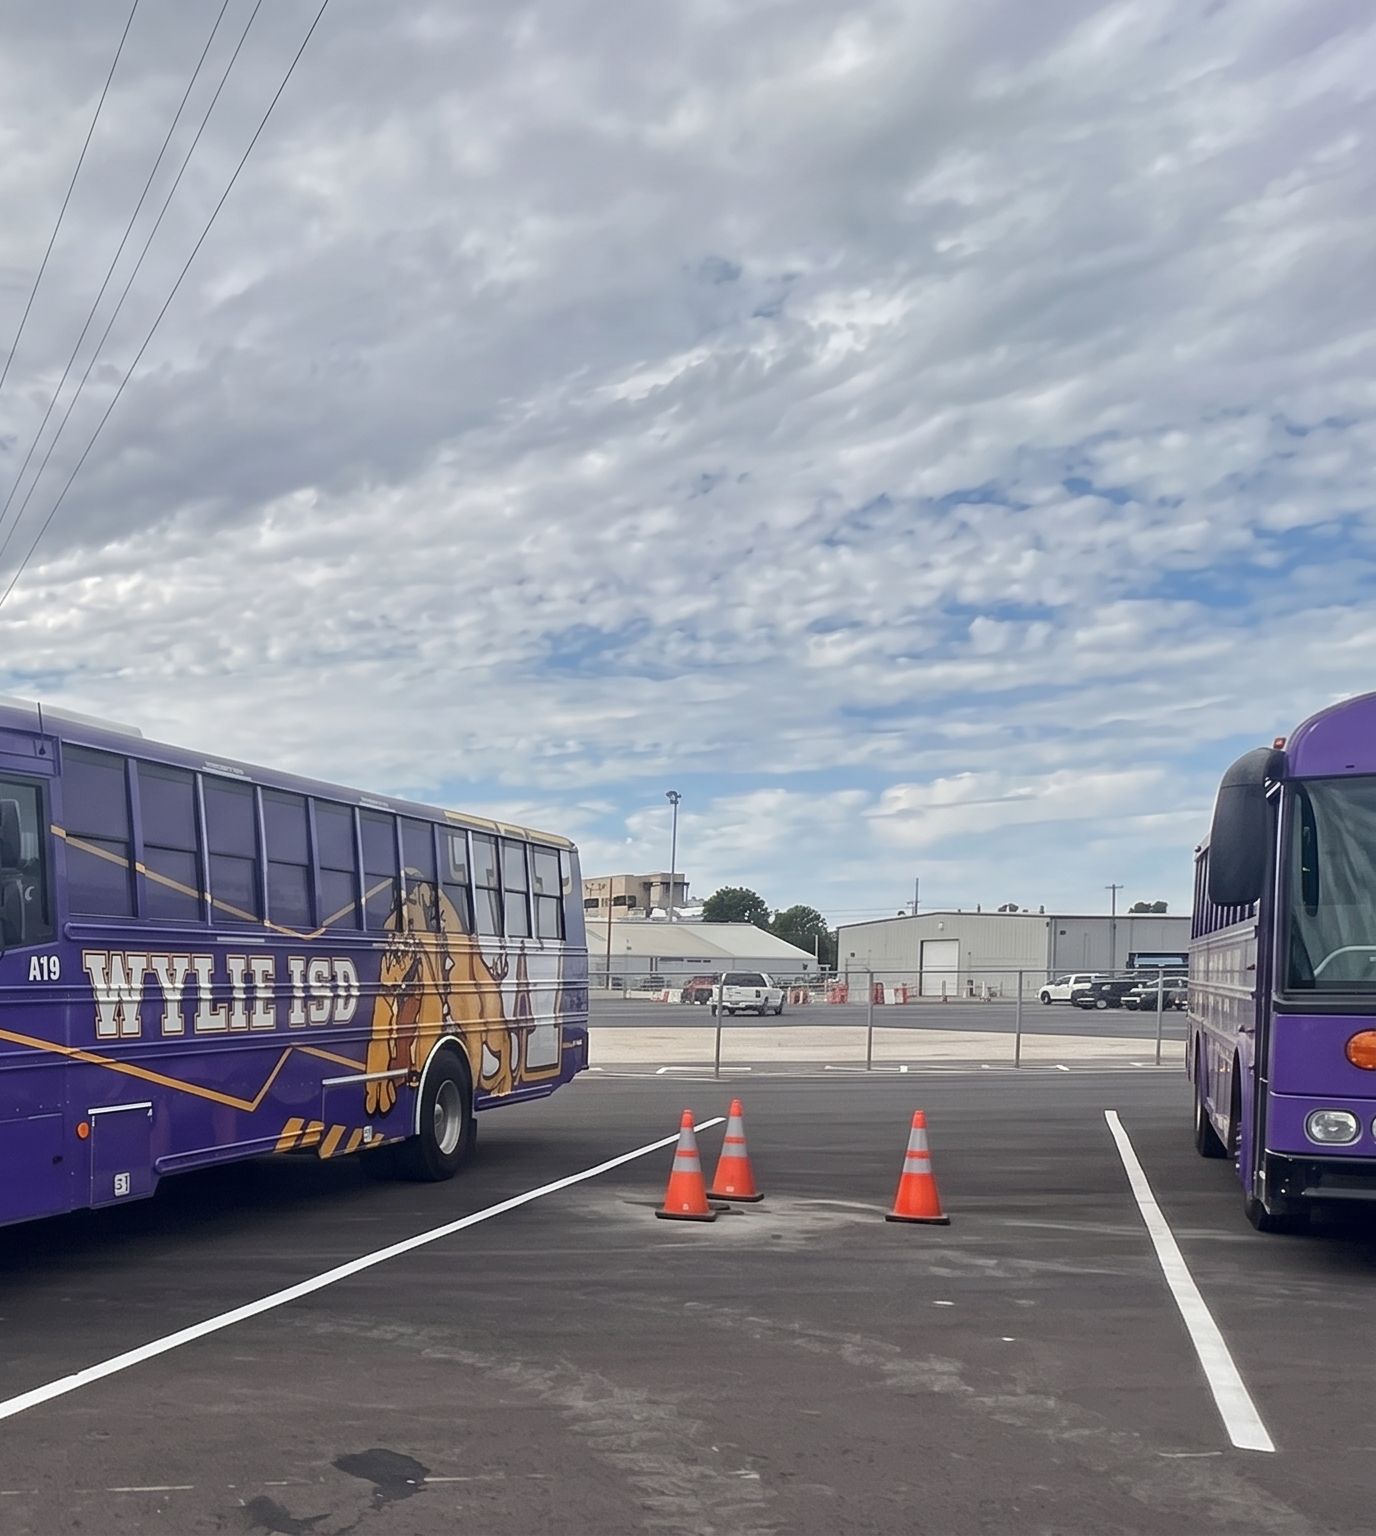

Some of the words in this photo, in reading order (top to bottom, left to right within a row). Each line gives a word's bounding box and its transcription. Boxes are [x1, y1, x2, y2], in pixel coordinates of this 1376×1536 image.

[28, 955, 61, 981] A19
[82, 950, 277, 1039] WYLIE
[288, 954, 361, 1028] ISD
